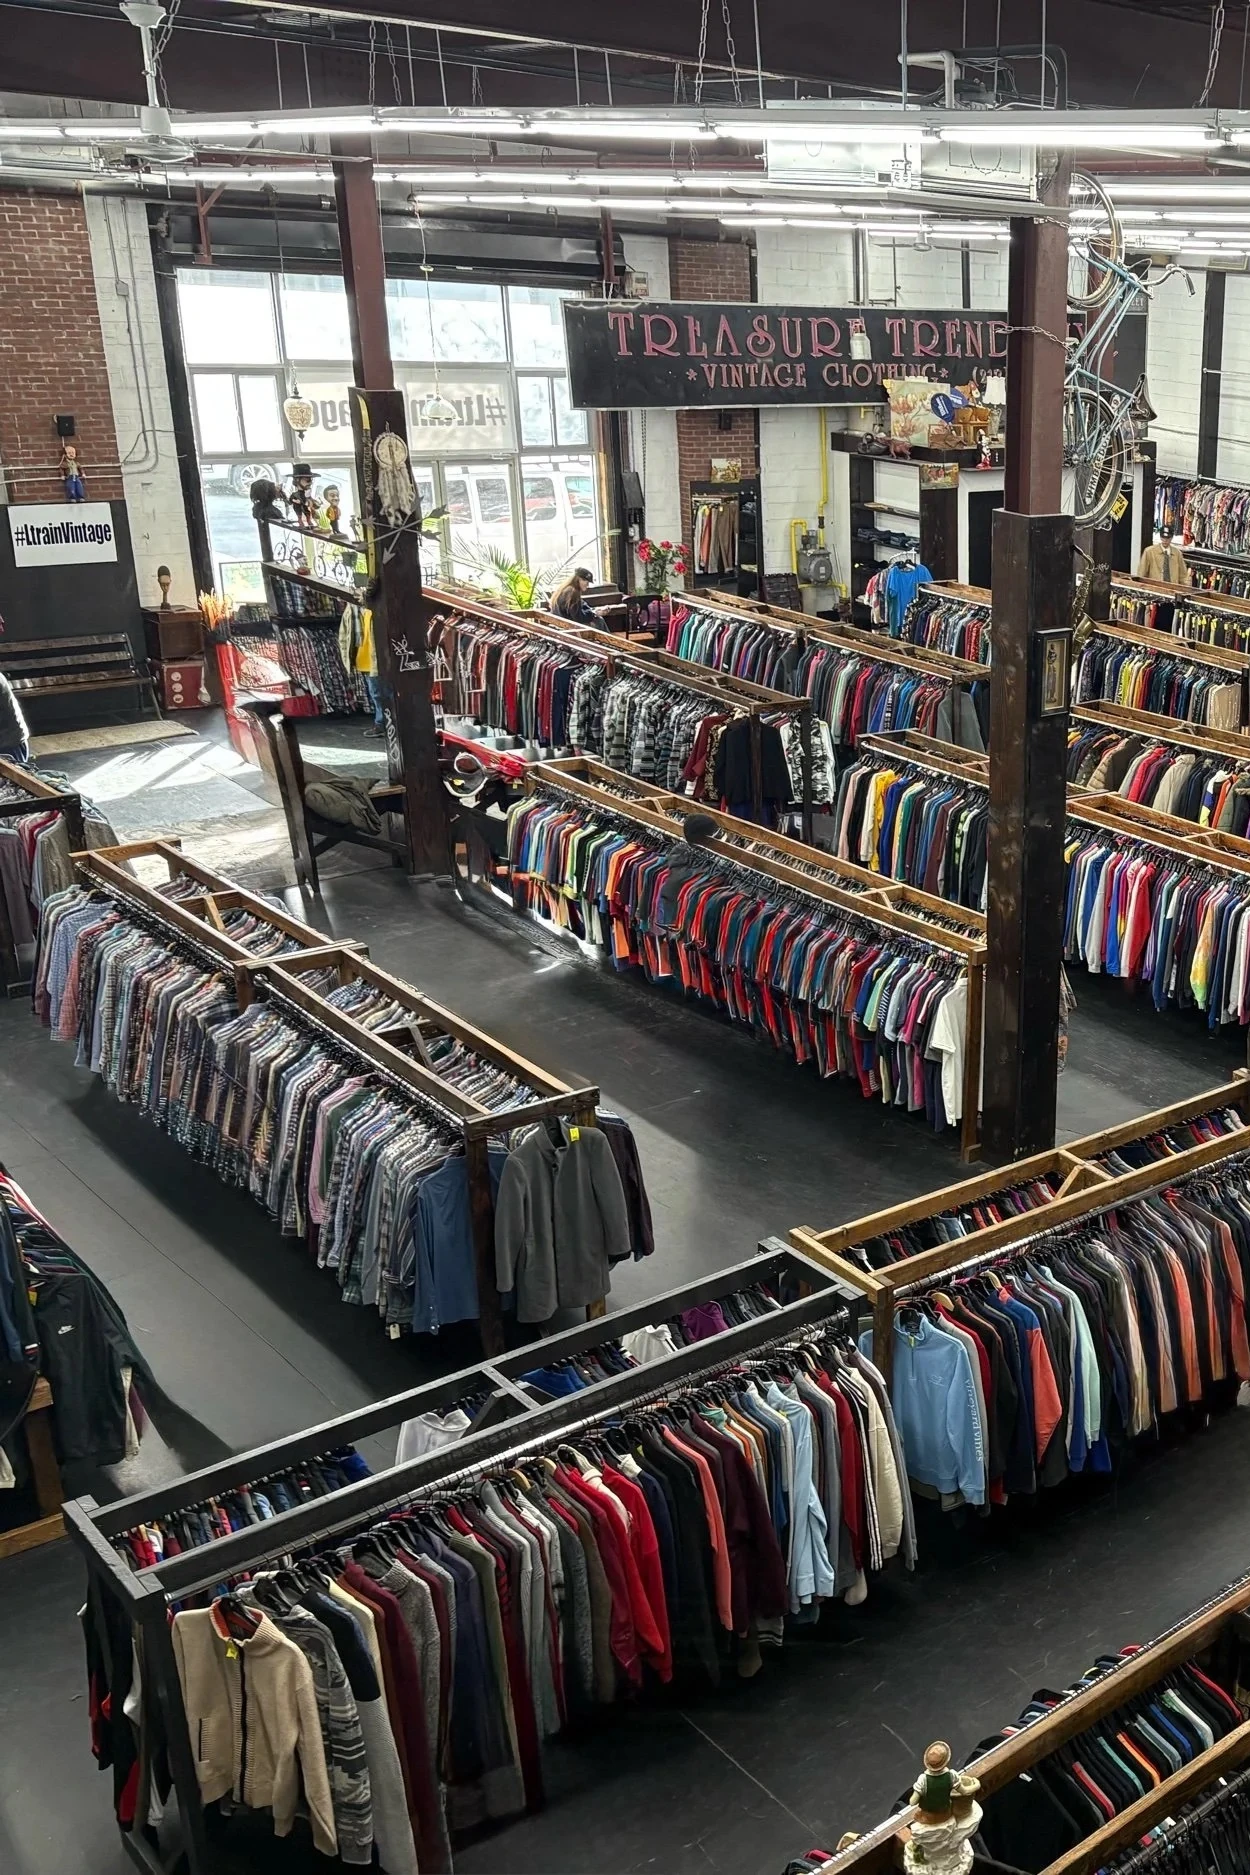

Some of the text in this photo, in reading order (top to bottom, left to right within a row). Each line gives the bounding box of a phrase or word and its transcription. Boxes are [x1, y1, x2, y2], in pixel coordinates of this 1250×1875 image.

[700, 362, 807, 389] VINTAGE
[822, 361, 938, 388] CLOTHING
[14, 522, 113, 547] #LtrainVintage
